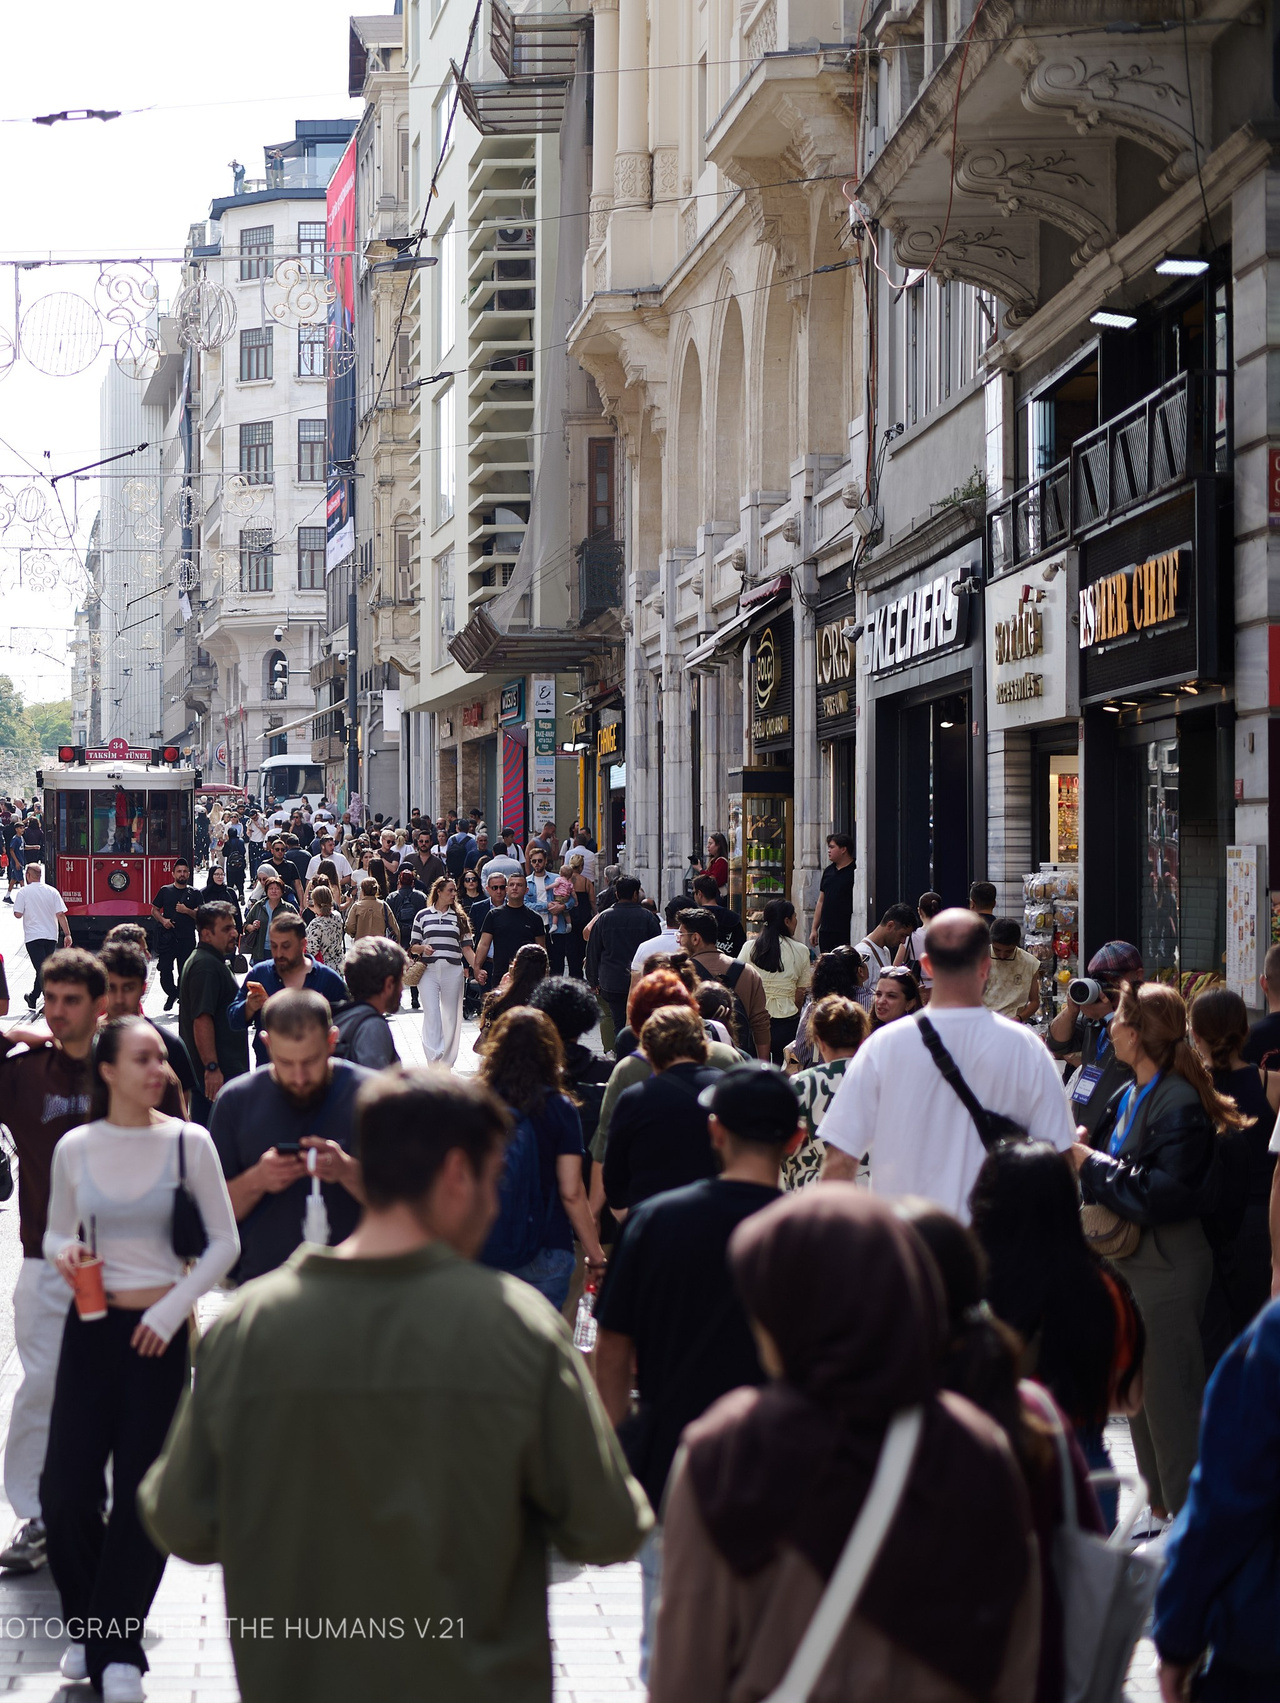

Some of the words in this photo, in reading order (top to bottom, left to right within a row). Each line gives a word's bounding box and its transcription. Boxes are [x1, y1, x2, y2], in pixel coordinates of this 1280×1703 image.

[1079, 572, 1129, 649] ESMER
[1132, 549, 1179, 630] CHEF
[862, 570, 960, 676] SKECHERS
[816, 616, 851, 685] LORIS
[113, 741, 123, 749] 34
[597, 723, 617, 756] CHANGE
[88, 751, 117, 759] TAKSİM
[125, 751, 149, 759] TÜNEL
[66, 861, 74, 872] 34
[163, 861, 171, 872] 34
